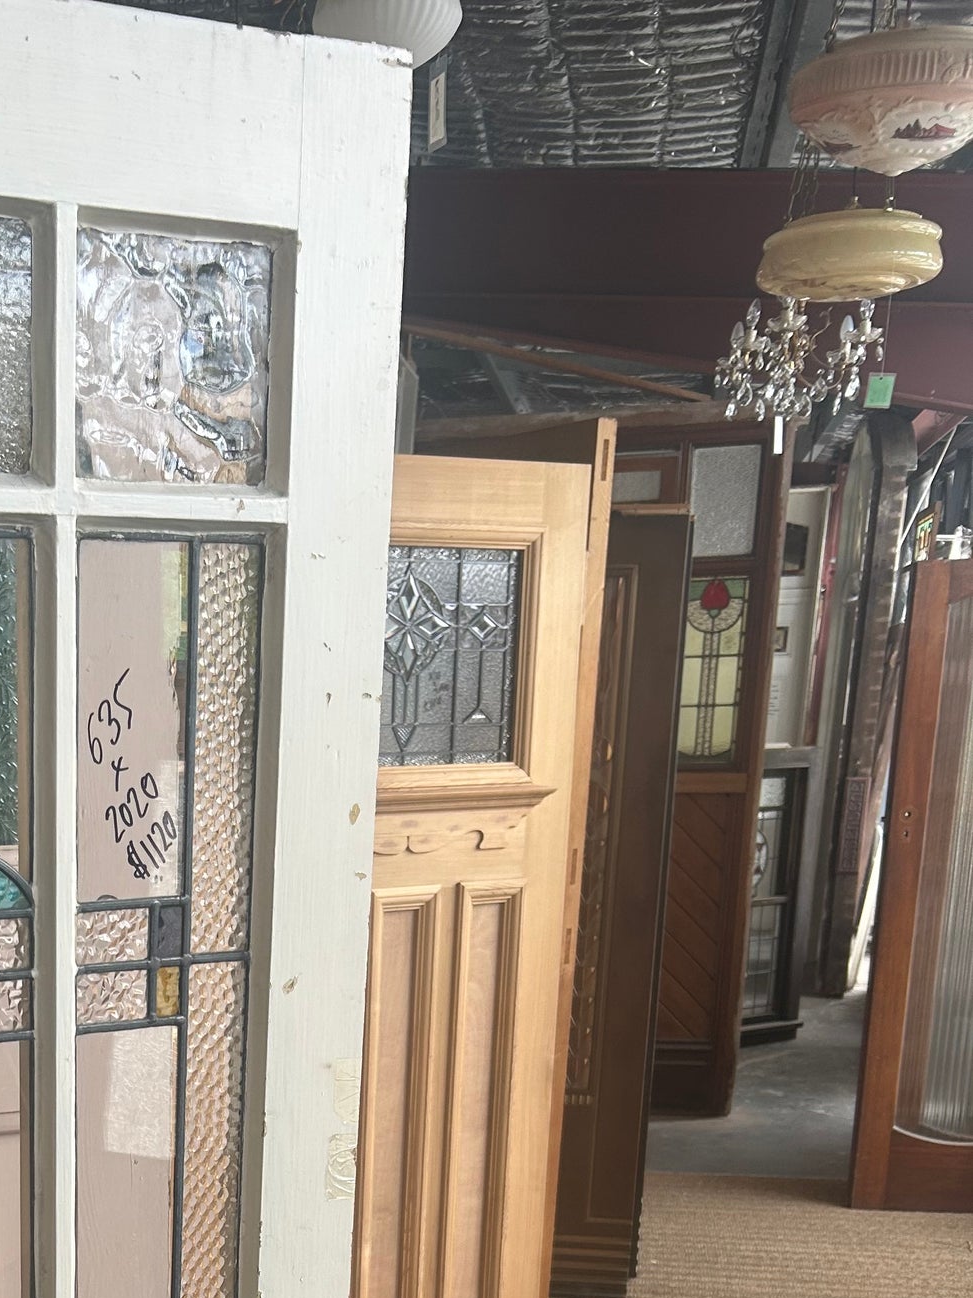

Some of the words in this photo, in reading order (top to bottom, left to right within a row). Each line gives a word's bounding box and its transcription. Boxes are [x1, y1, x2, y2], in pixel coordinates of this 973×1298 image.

[88, 668, 132, 764] 635
[105, 773, 158, 843] 2020
[127, 811, 177, 879] $1120
